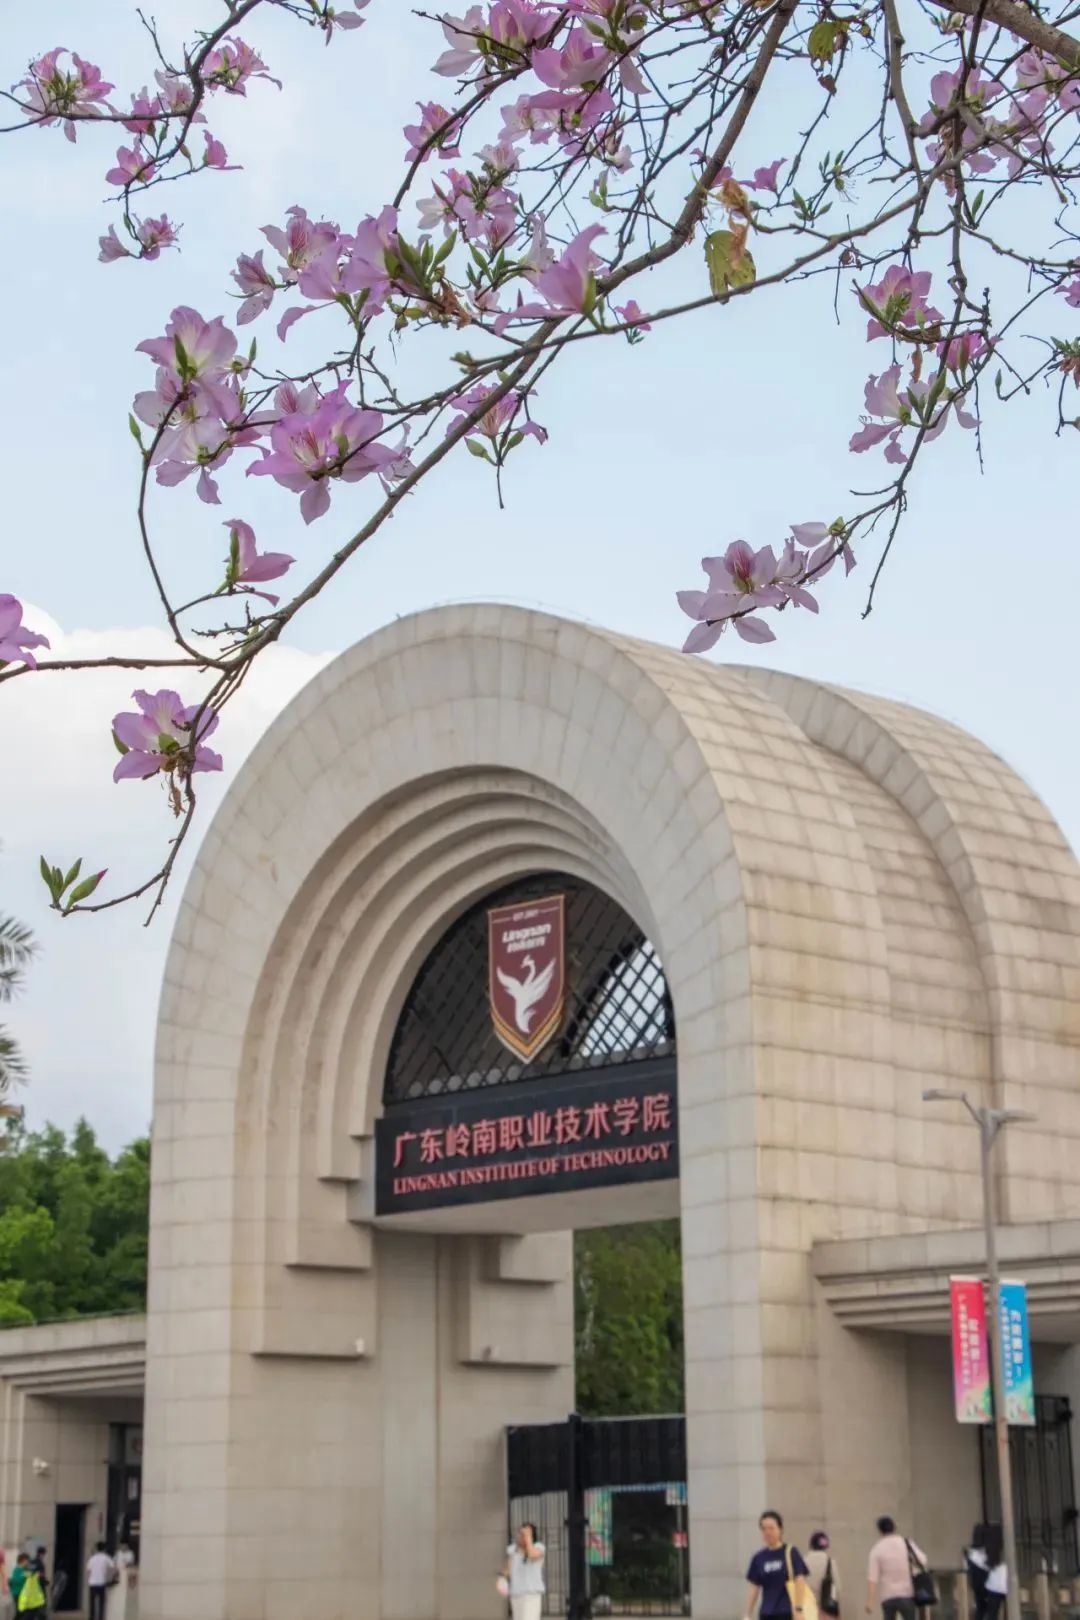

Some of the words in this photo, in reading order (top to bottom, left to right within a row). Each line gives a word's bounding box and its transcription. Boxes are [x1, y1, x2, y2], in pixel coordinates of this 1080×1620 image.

[393, 1093, 671, 1168] 广东岭南职业技术学院
[393, 1170, 458, 1195] LINGNAN
[460, 1159, 538, 1186] INSTITUTE
[539, 1156, 559, 1175] OF
[563, 1141, 671, 1172] TECHNOLOGY
